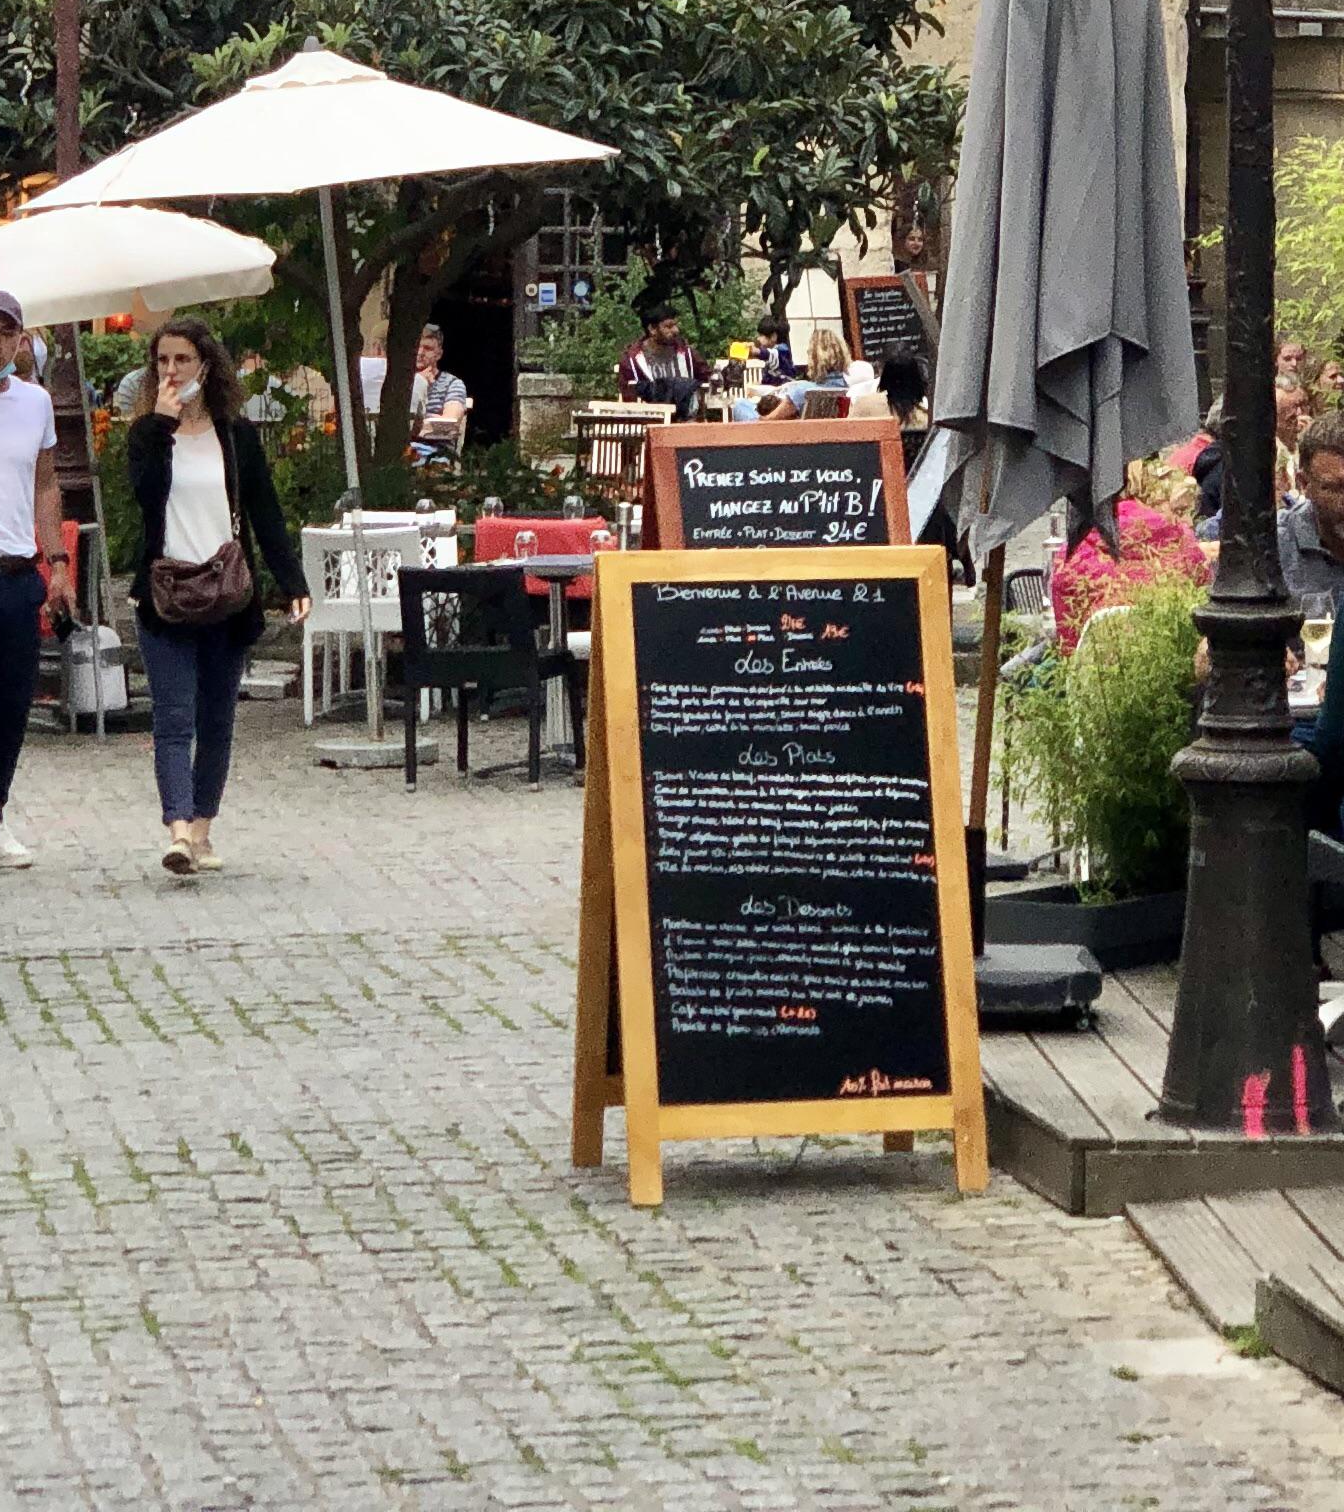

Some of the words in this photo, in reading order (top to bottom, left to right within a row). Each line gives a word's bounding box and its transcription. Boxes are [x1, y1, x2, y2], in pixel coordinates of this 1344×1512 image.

[683, 458, 744, 489] PRENEZ
[790, 468, 810, 483] DE
[710, 500, 773, 519] MANGEZ
[778, 499, 800, 514] AU
[822, 521, 868, 543] 24€
[652, 583, 742, 602] Bienvenue
[748, 584, 759, 600] à
